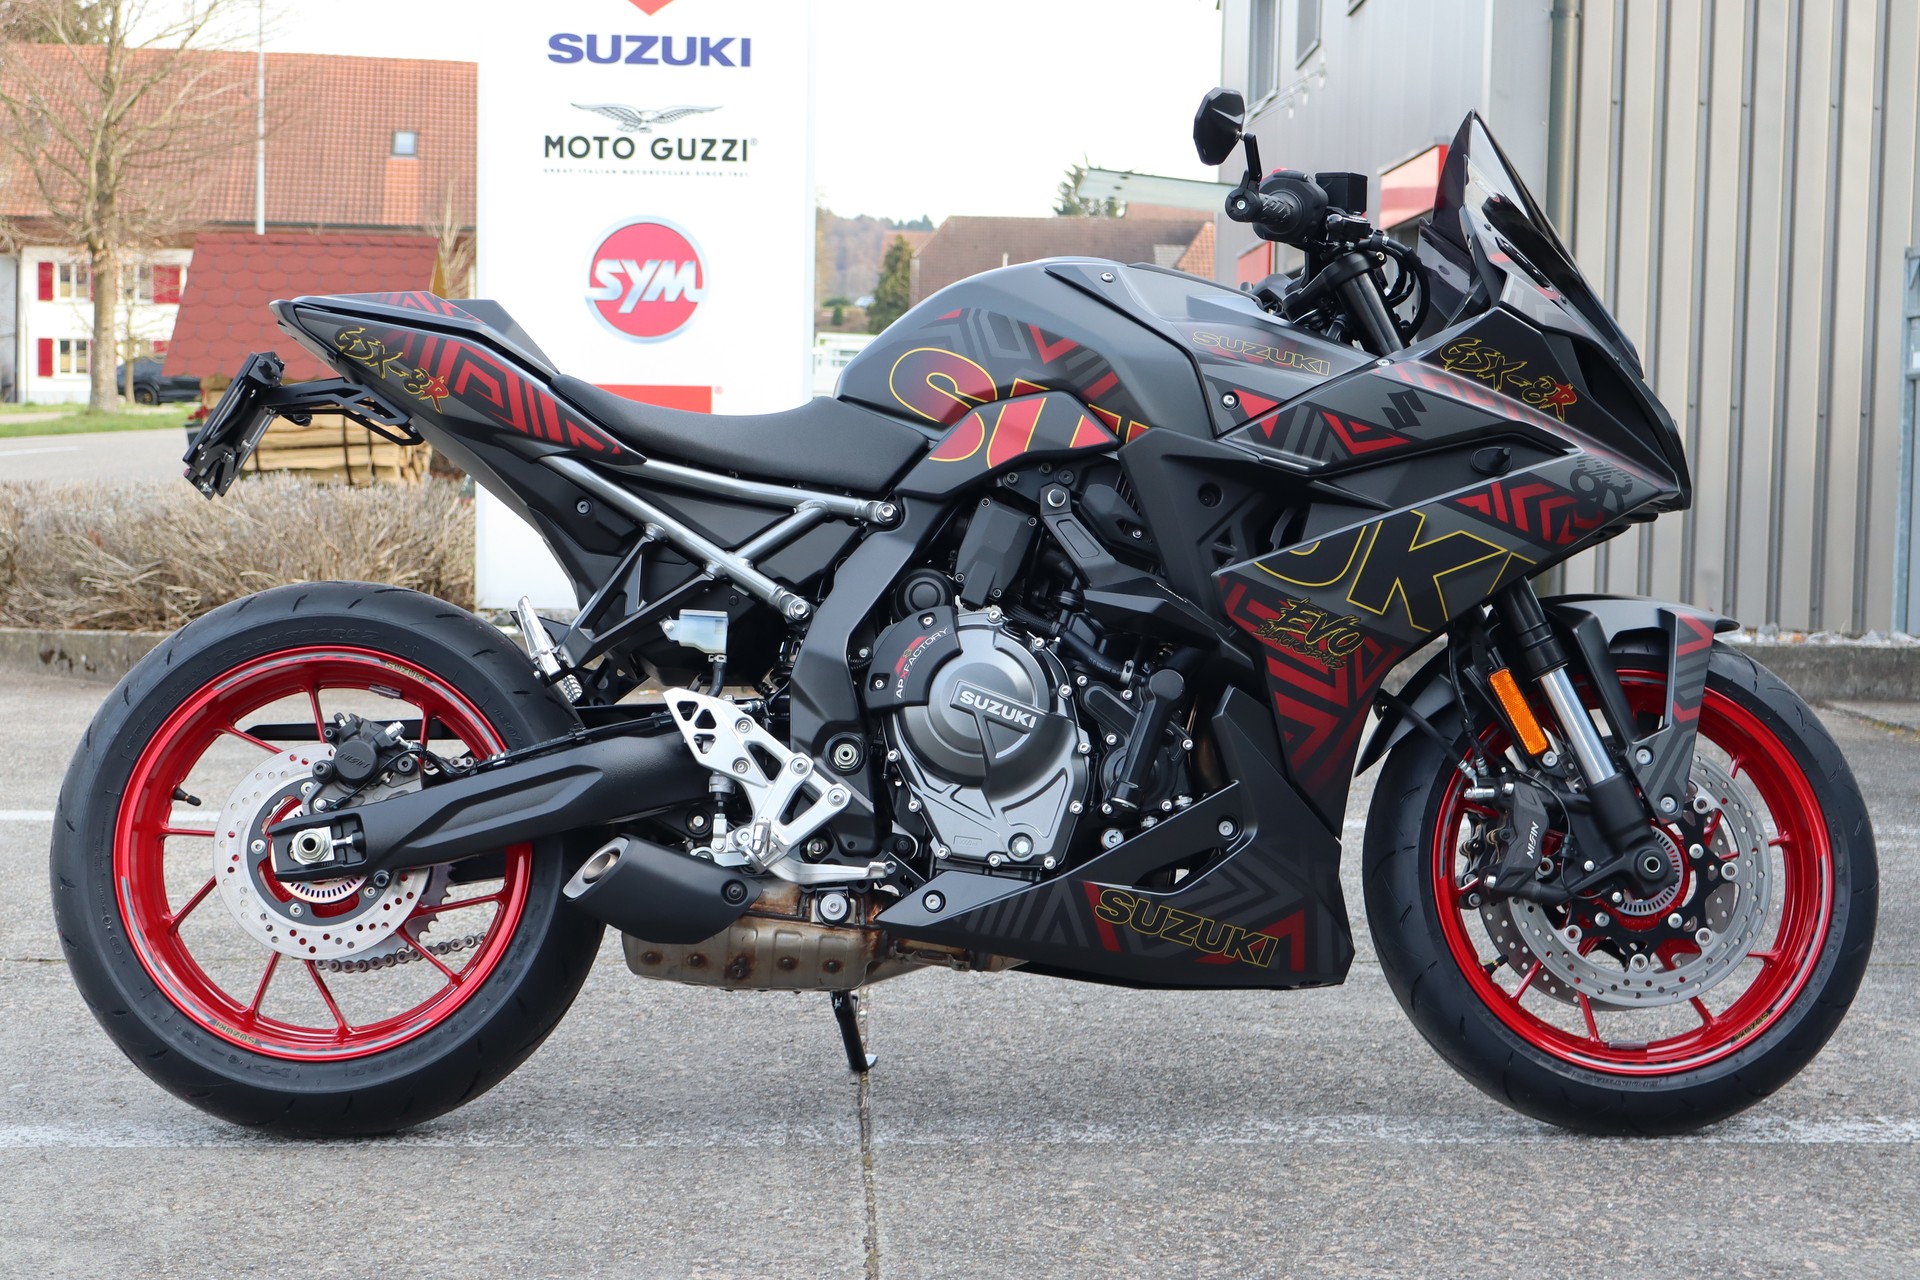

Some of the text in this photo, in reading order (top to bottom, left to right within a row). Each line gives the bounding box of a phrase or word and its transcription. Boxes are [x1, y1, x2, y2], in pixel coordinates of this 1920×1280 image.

[547, 33, 751, 67] SUZUKI
[545, 135, 635, 160] MOTO
[587, 259, 700, 314] SYM
[1192, 331, 1331, 376] SUZUKI
[1440, 337, 1577, 423] GSX-8R
[1266, 597, 1365, 656] EVO
[960, 690, 1037, 729] SUZUKI
[1526, 820, 1539, 860] NISSIN
[1095, 888, 1279, 967] SUZUKI
